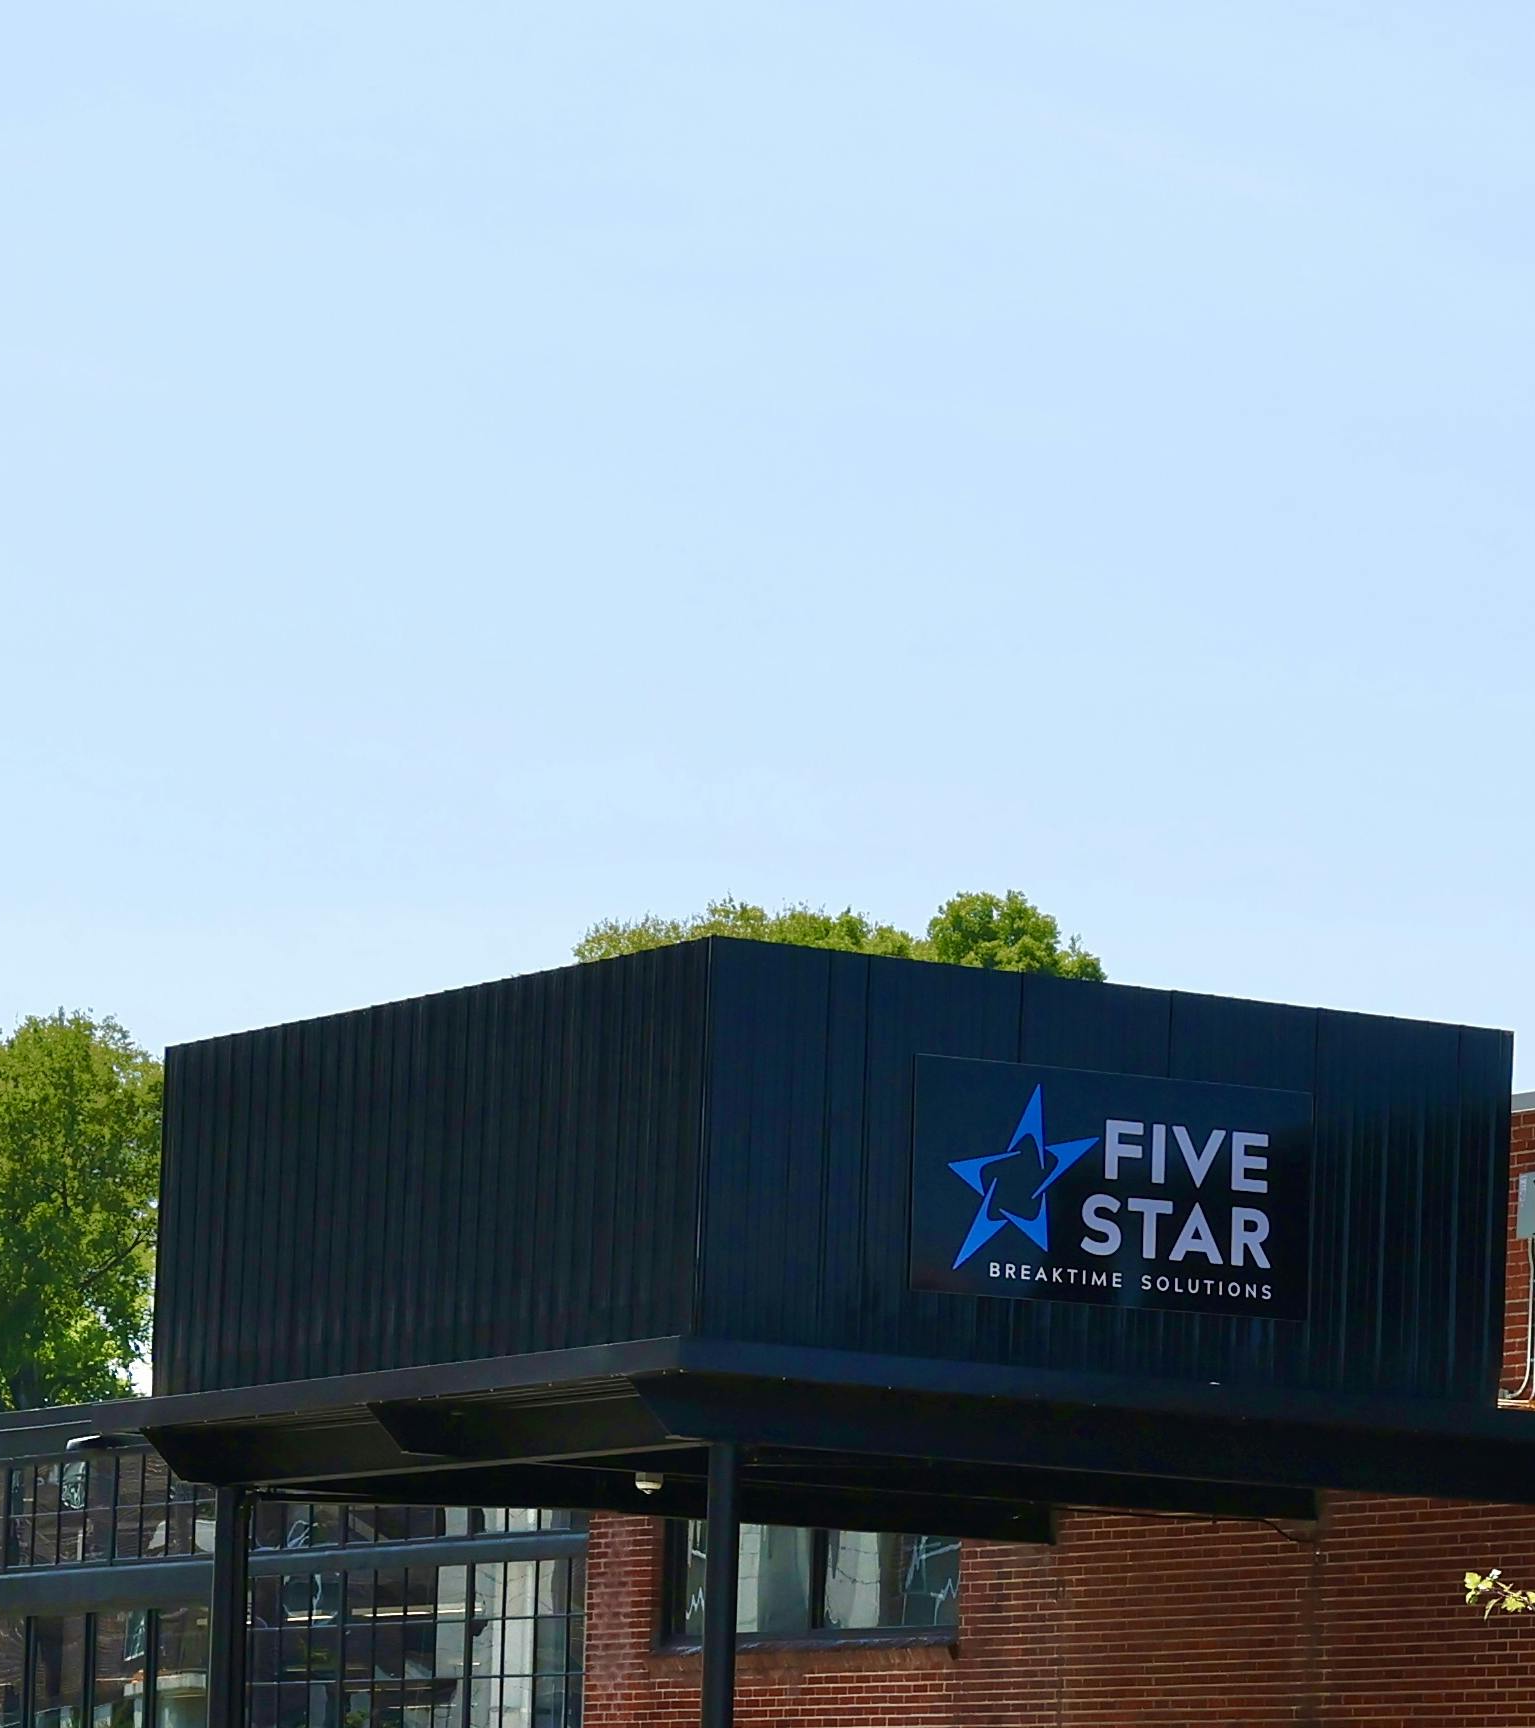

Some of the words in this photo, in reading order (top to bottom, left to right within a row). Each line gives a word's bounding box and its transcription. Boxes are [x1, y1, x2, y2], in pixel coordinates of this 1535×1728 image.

[1104, 1119, 1269, 1194] FIVE
[1080, 1193, 1271, 1269] STAR
[989, 1262, 1123, 1288] BREAKTIME
[1141, 1275, 1272, 1300] SOLUTIONS
